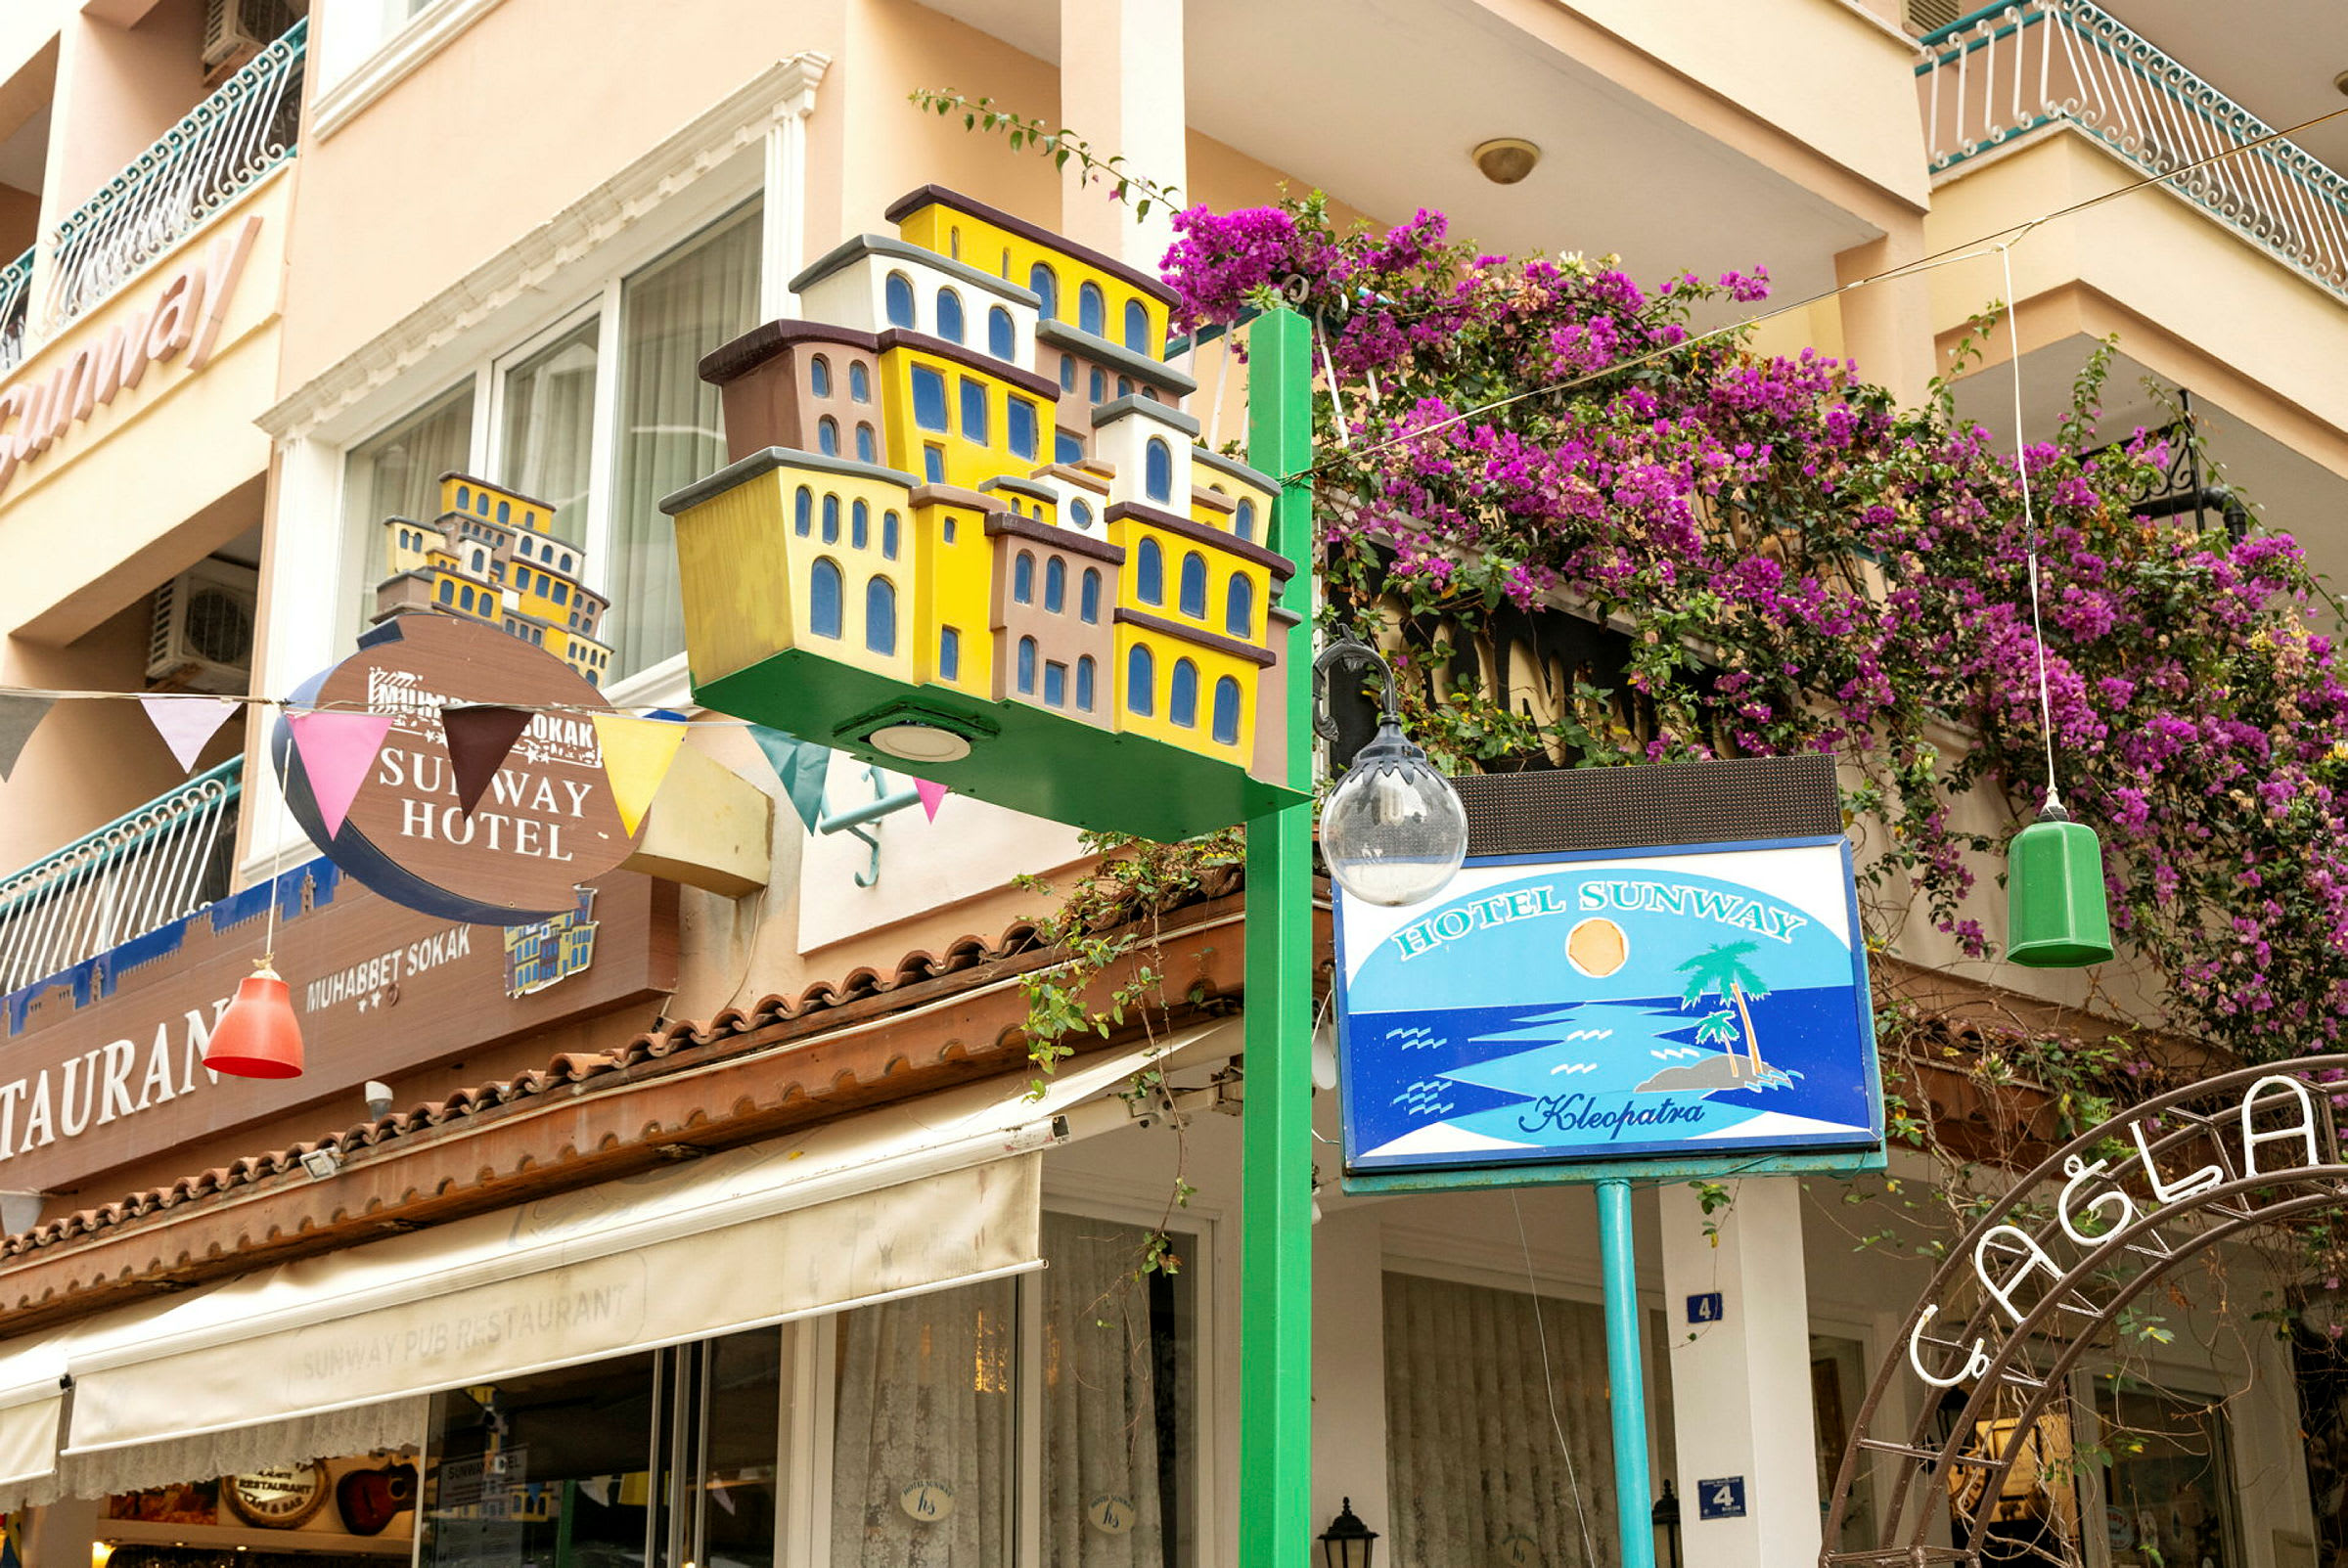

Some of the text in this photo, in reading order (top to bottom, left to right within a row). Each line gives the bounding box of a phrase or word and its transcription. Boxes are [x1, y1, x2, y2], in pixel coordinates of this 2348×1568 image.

[400, 798, 573, 862] HOTEL
[1390, 880, 1808, 961] HOTEL SUNWAY
[306, 922, 471, 1013] MUHABBET SOKAK
[0, 994, 237, 1162] TAURAN
[1518, 1093, 1705, 1141] Kleopatra
[1698, 1297, 1711, 1320] 4
[403, 1323, 448, 1361] PUB
[1712, 1485, 1735, 1506] 4
